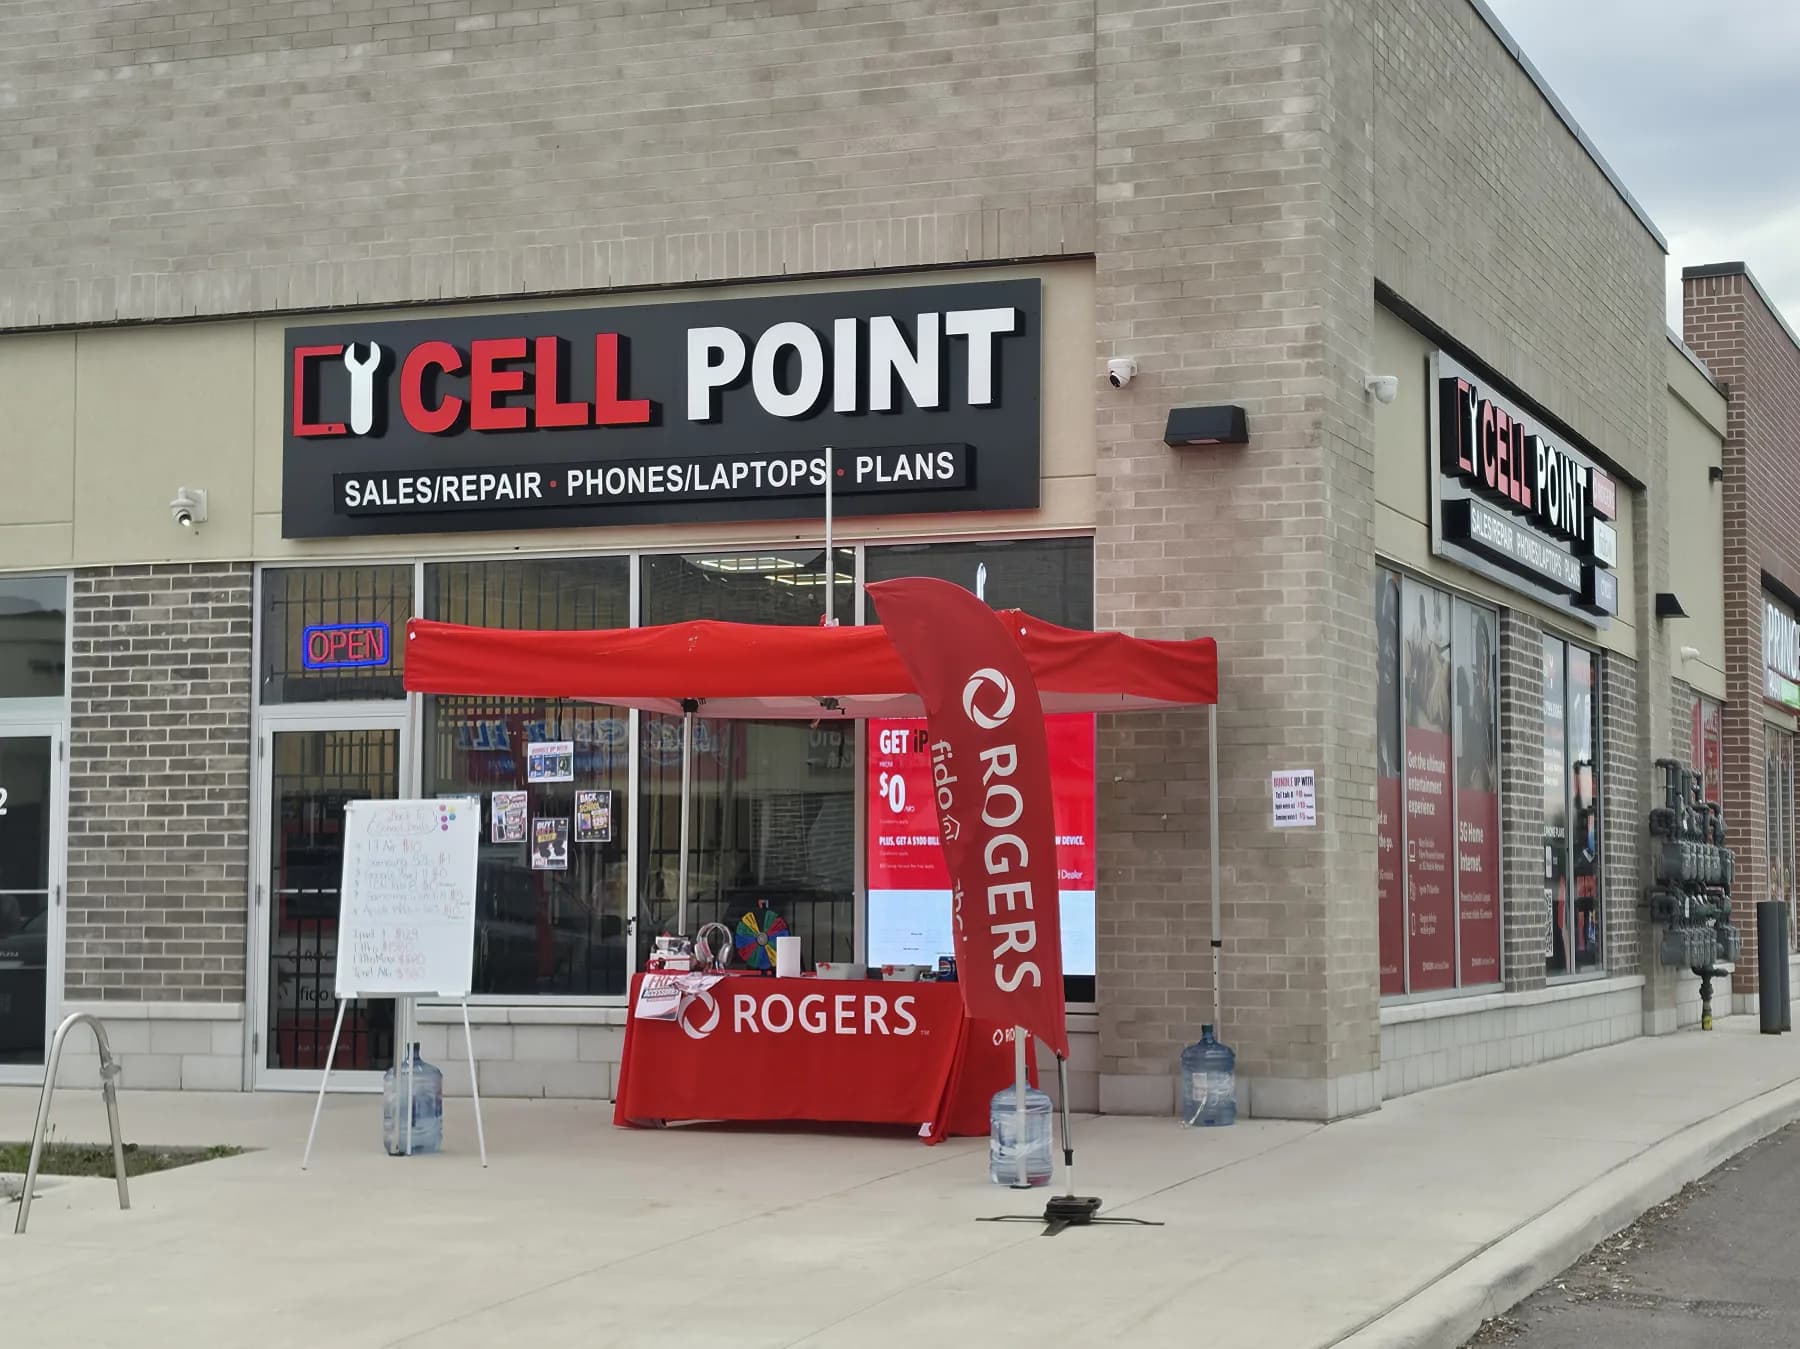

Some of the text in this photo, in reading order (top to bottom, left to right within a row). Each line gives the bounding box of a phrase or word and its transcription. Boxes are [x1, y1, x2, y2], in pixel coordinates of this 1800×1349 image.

[401, 307, 1016, 434] CELL POINT
[344, 451, 956, 507] SALES/REPAIR PHONES/LAPTOPS PLANS
[1482, 399, 1587, 541] CELL POINT
[309, 628, 383, 662] OPEN
[880, 729, 928, 754] GET iP
[931, 739, 958, 811] fido
[1301, 776, 1313, 787] WITH
[896, 836, 906, 846] GET
[906, 836, 912, 846] A
[979, 743, 1042, 993] ROGERS
[734, 993, 917, 1037] ROGERS
